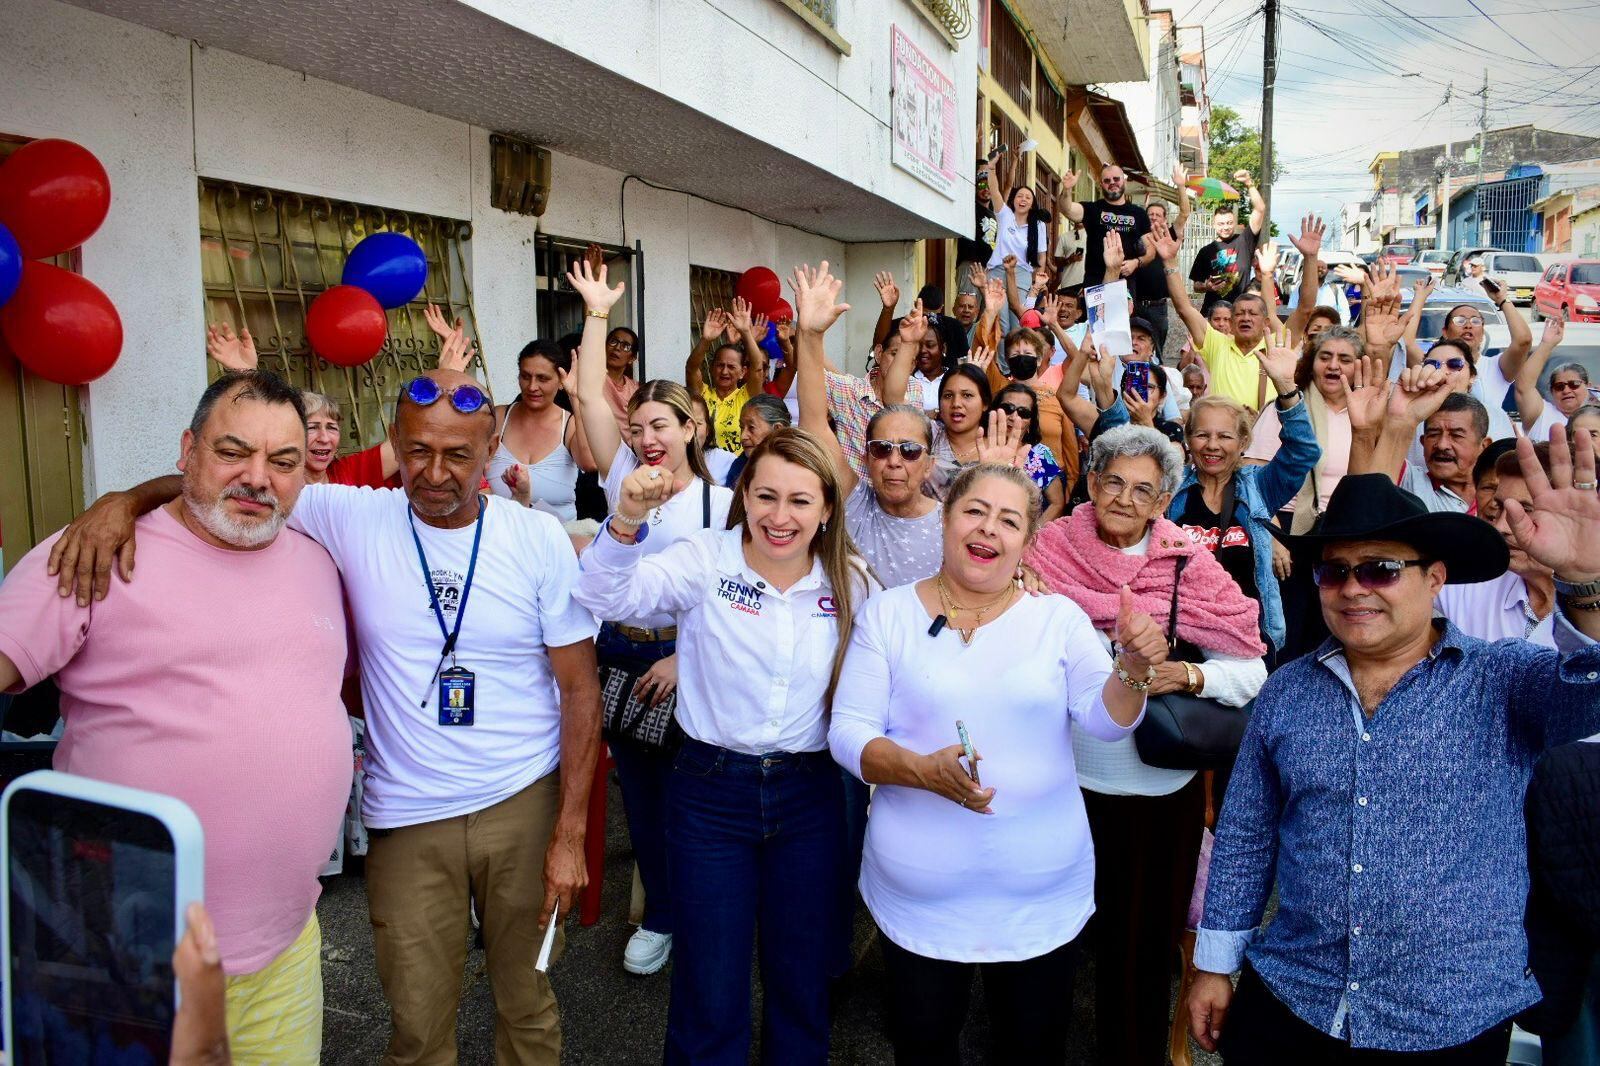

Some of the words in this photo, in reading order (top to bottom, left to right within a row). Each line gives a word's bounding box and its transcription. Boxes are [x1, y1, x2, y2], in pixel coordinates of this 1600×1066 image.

[895, 30, 941, 90] FUNDACION
[430, 569, 465, 581] ROOKLYN
[716, 587, 762, 610] TRUJILLO
[720, 577, 762, 601] YENNY
